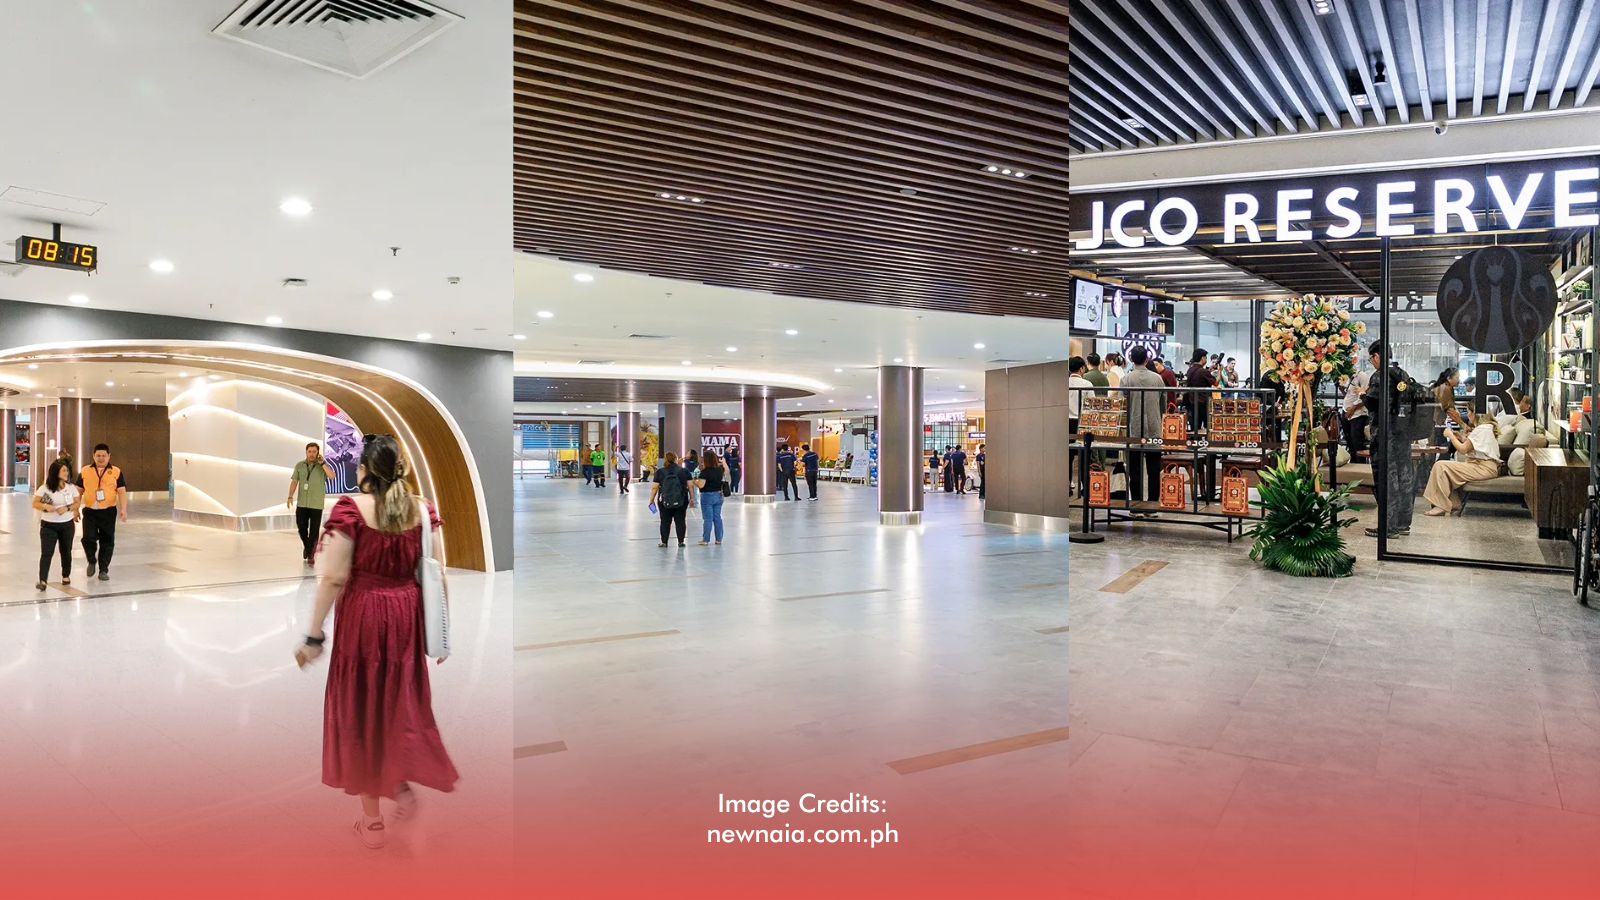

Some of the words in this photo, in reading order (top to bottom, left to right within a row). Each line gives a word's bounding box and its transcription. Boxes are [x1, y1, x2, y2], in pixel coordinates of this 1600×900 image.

[1075, 197, 1199, 250] JCO
[1223, 167, 1599, 244] RESERVE
[27, 238, 93, 267] 08:15
[1475, 362, 1518, 416] R
[701, 436, 738, 447] MAMA
